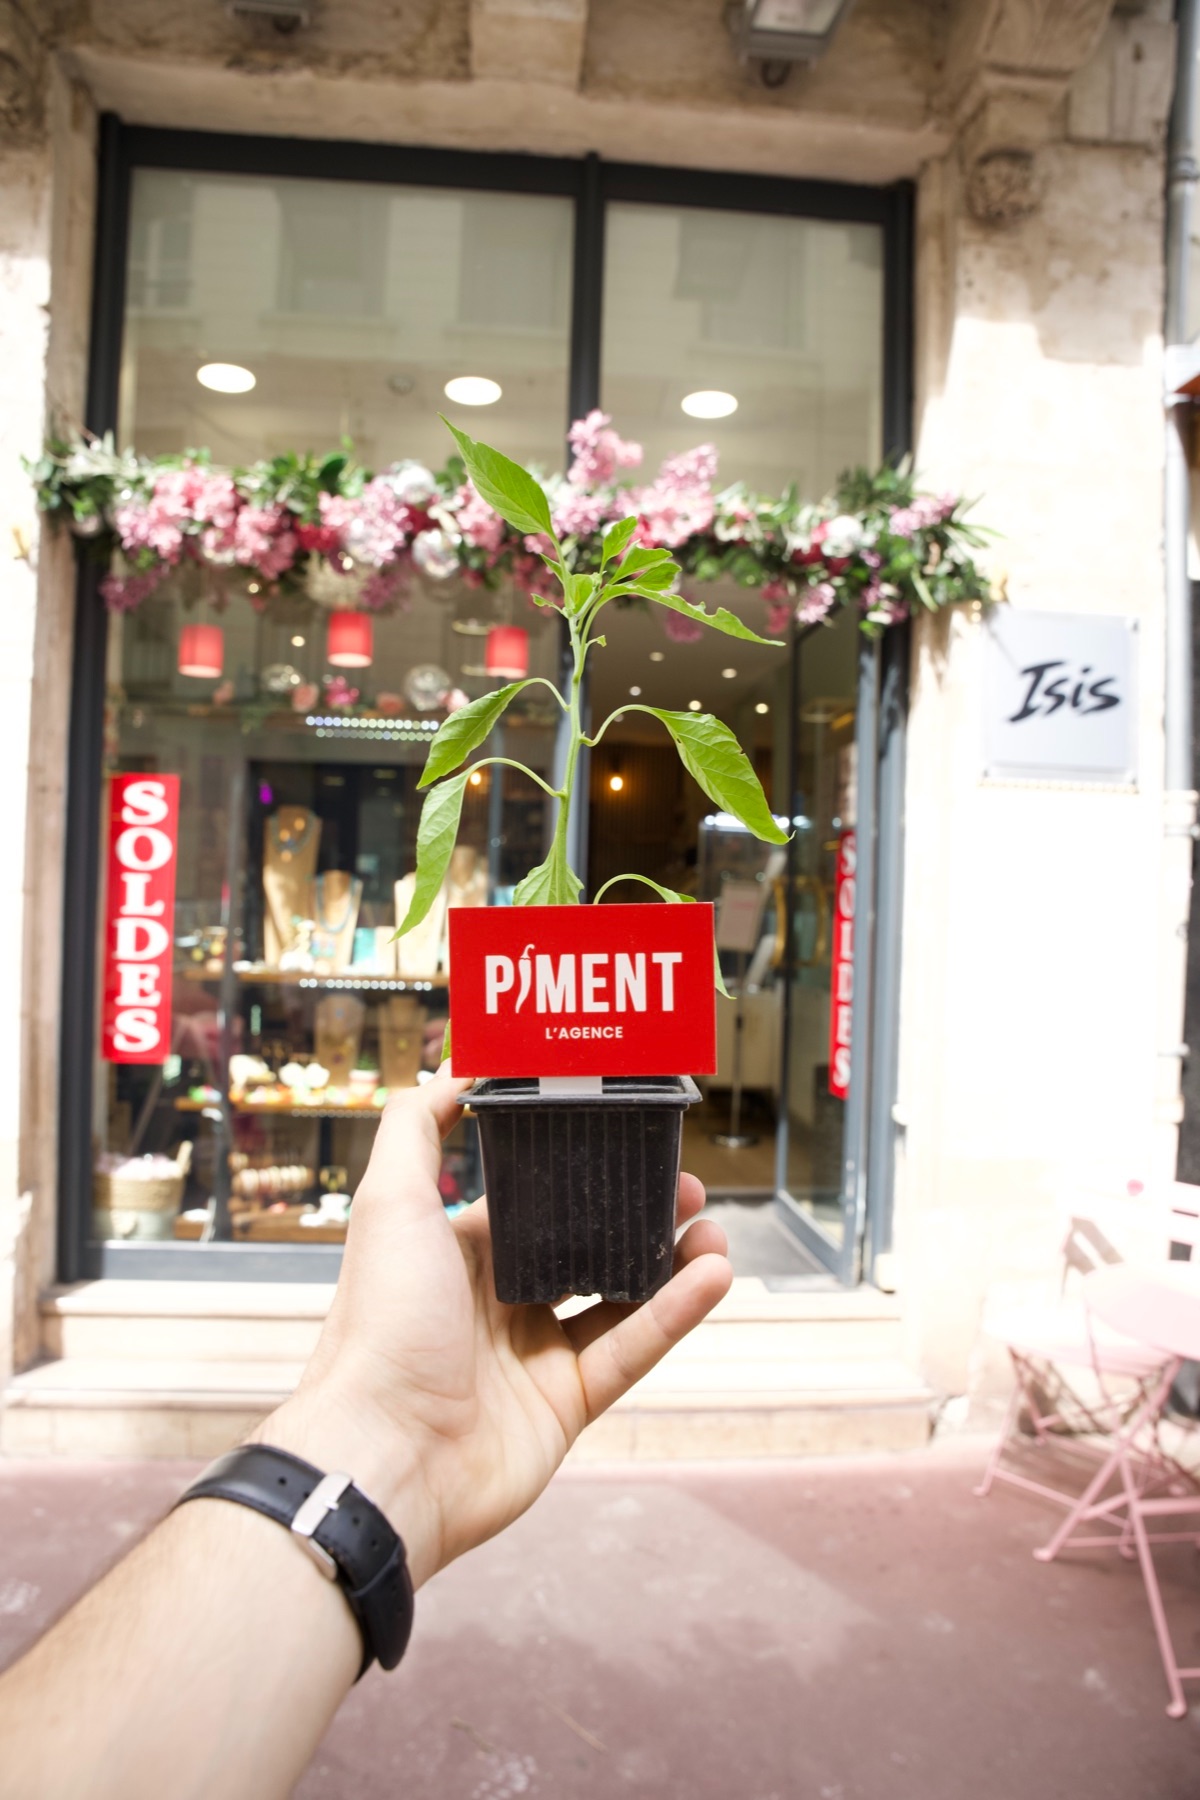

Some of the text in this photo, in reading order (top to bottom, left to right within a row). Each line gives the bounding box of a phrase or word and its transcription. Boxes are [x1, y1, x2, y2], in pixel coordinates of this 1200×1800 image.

[1008, 660, 1121, 722] Isis
[112, 780, 173, 1053] SOLDES
[485, 943, 683, 1015] PIMENT
[545, 1026, 624, 1040] L'AGENCE
